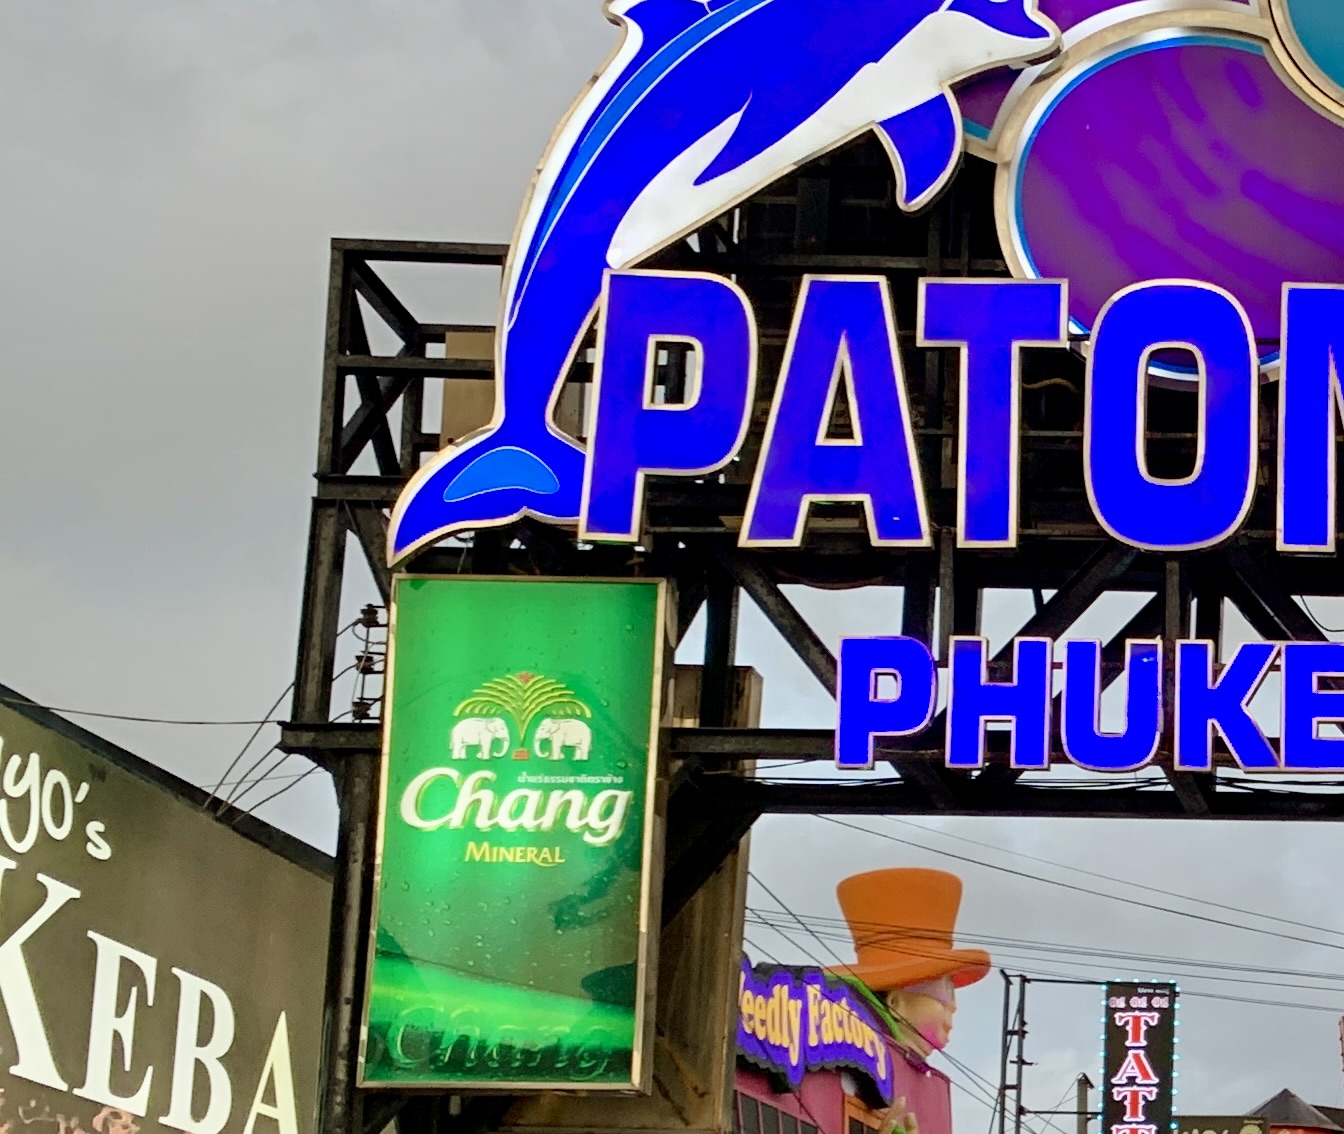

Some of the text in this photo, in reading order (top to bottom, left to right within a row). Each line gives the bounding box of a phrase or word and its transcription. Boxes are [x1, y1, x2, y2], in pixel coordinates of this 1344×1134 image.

[399, 767, 634, 847] Chang
[739, 970, 888, 1081] eedly Factory
